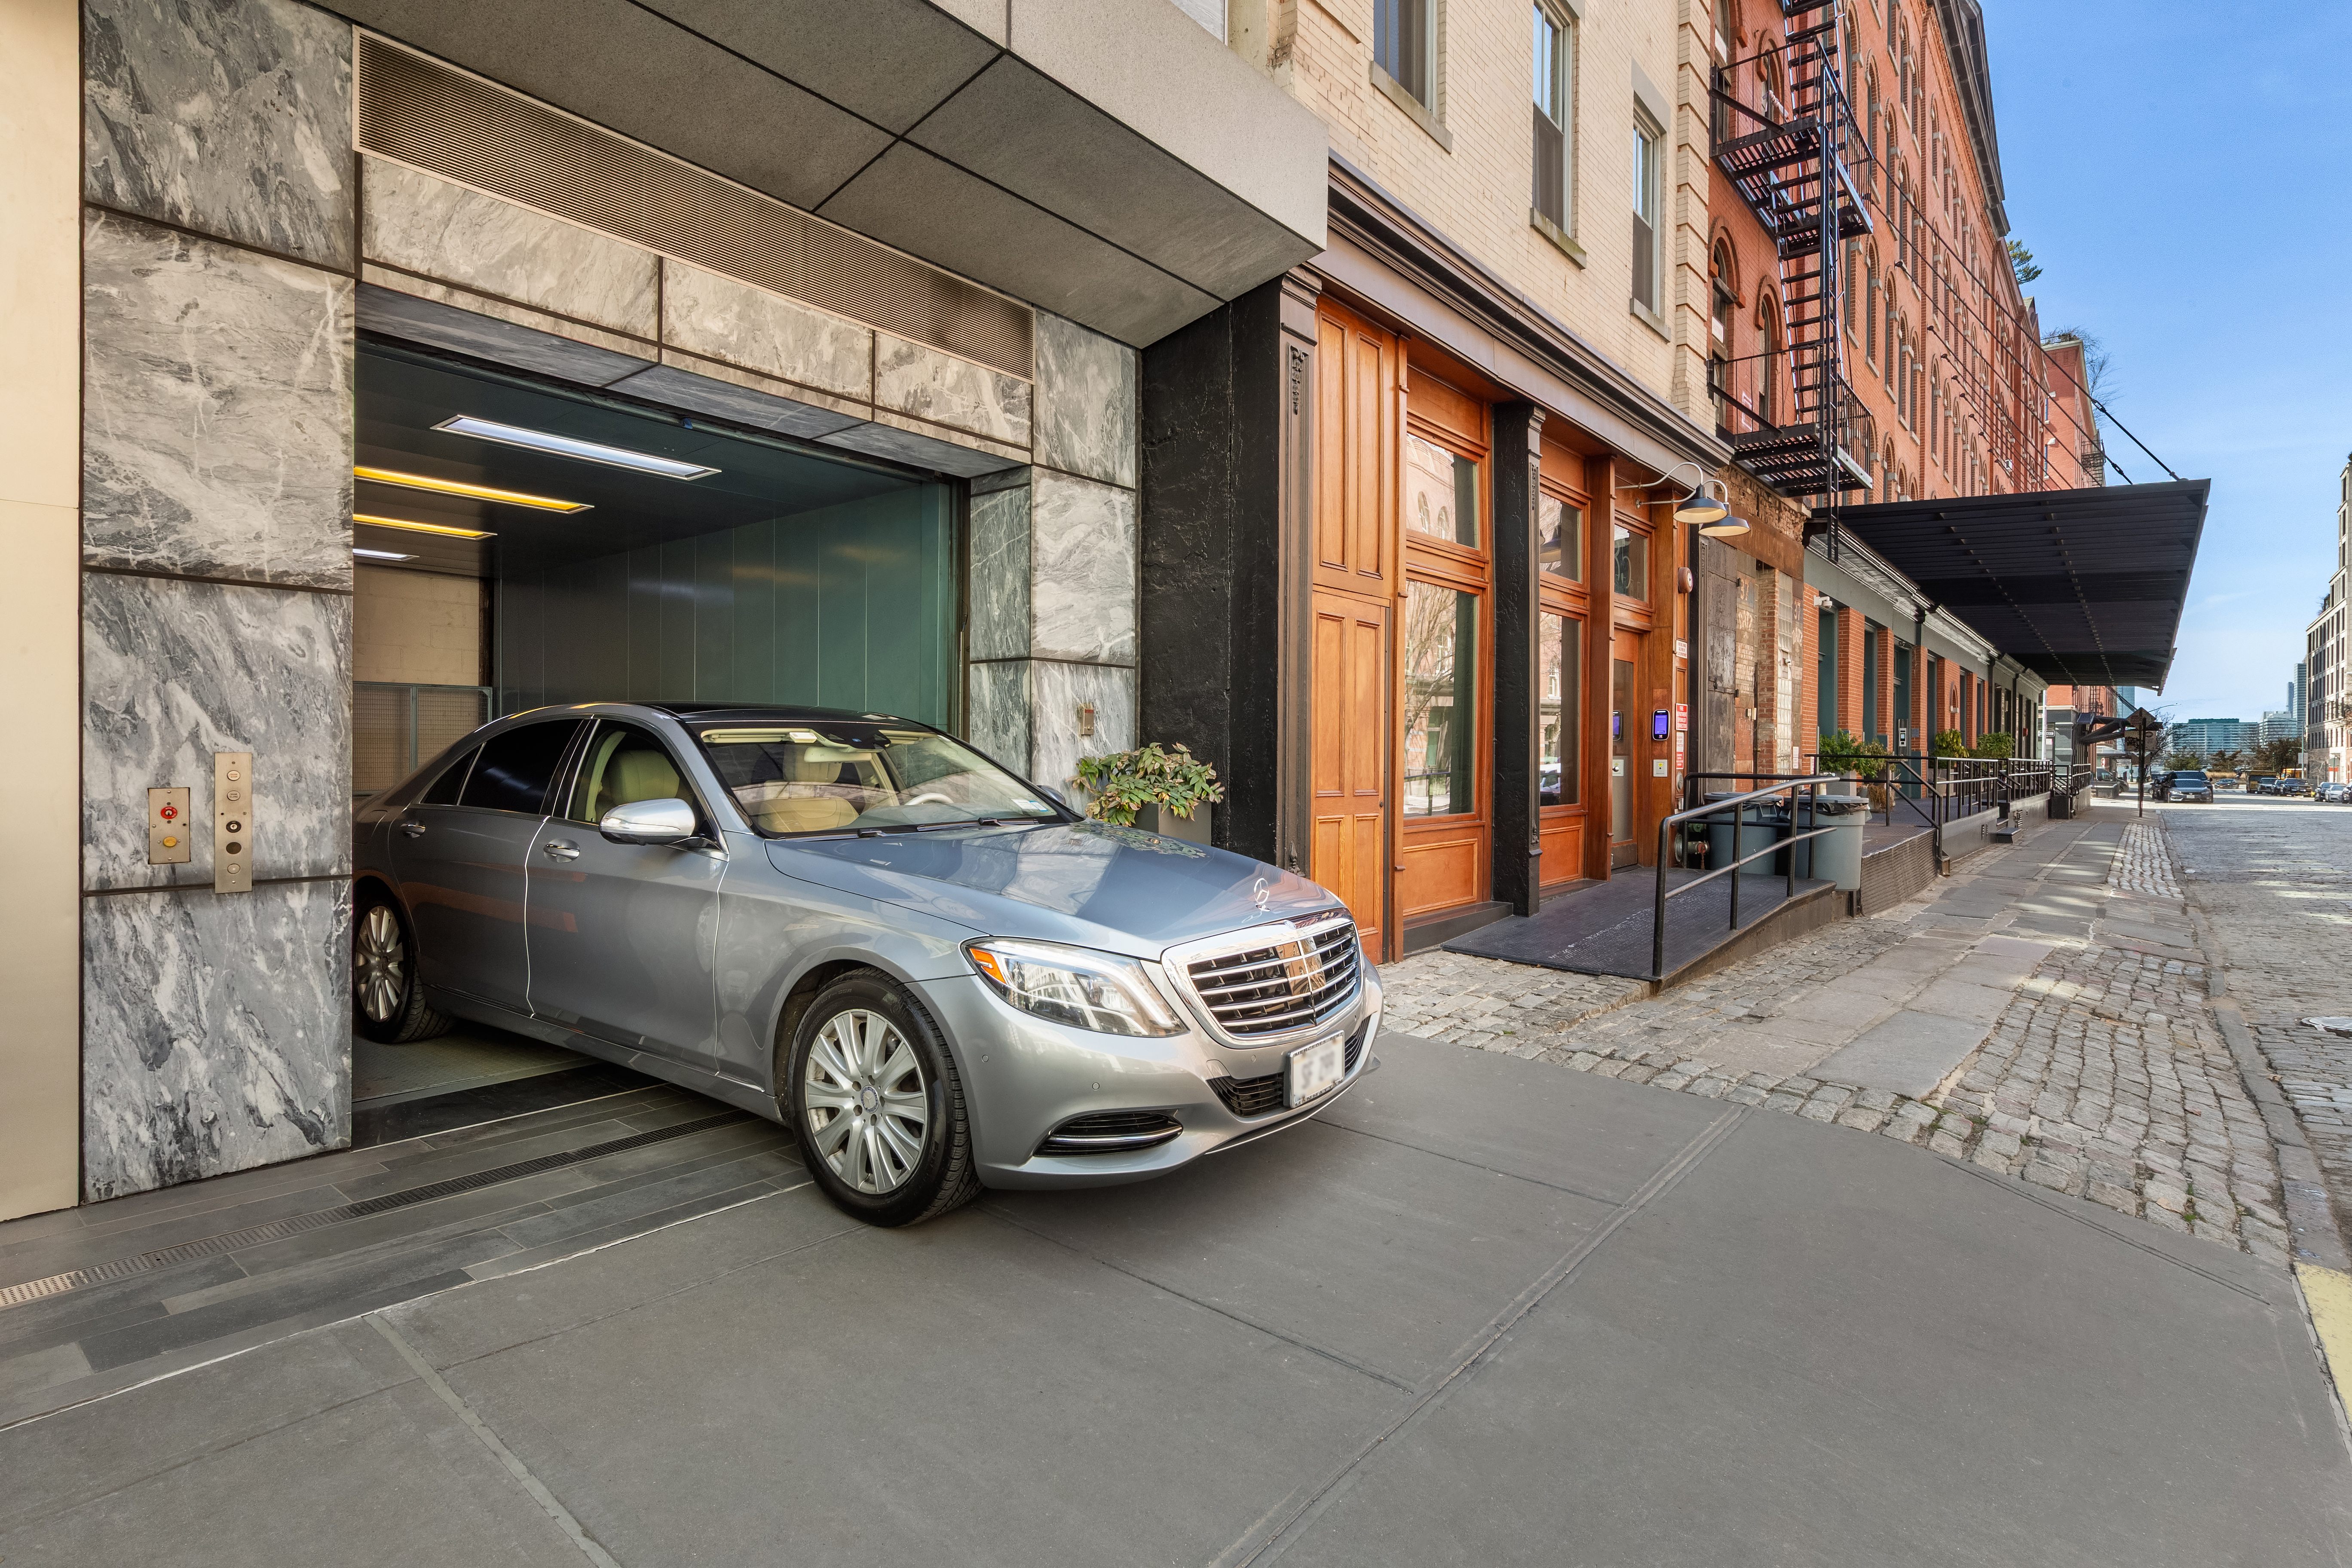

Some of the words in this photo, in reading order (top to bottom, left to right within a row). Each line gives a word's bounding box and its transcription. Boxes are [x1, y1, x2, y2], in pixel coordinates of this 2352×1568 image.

[1740, 578, 1749, 600] 37
[1794, 600, 1801, 621] 37
[1295, 1079, 1343, 1107] MANHATTAN
